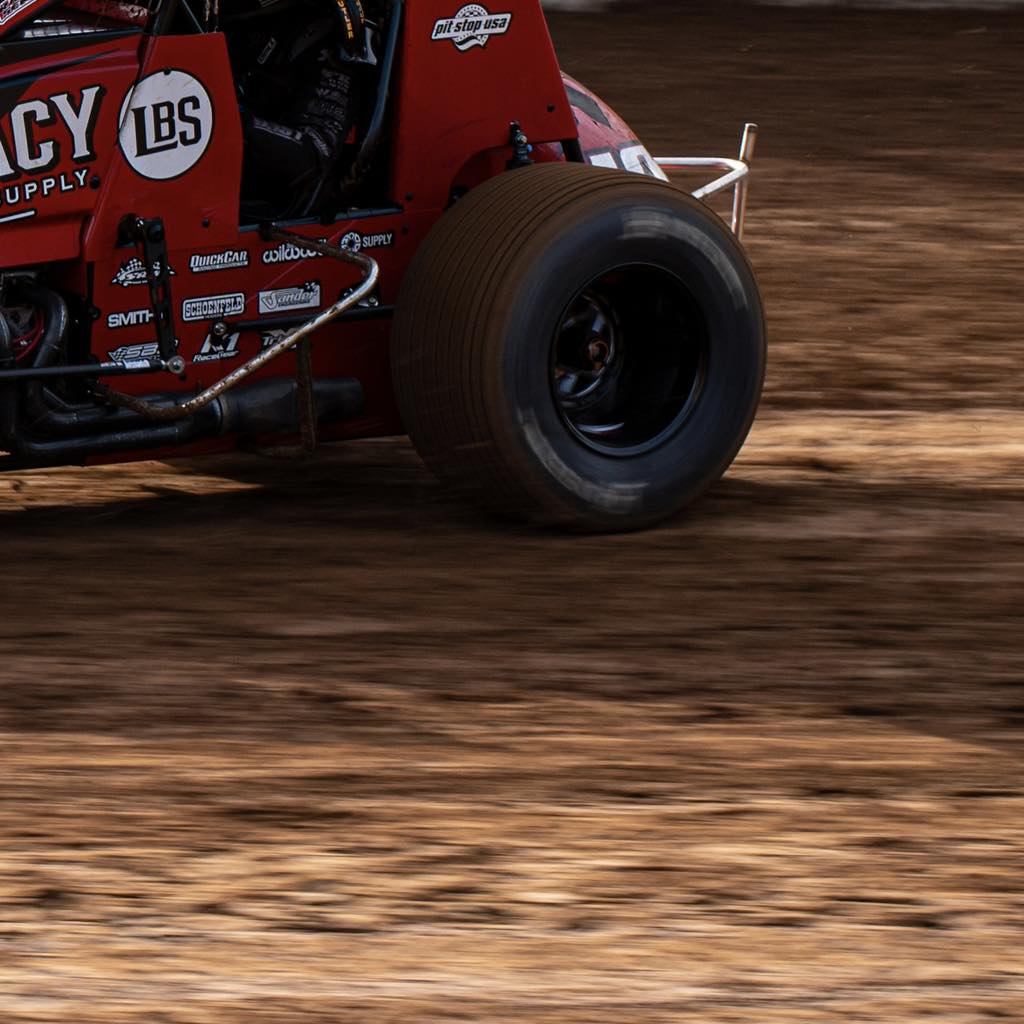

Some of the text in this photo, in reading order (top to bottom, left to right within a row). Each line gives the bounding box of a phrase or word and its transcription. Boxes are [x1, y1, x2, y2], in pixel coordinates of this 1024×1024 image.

[434, 16, 507, 37] pit stop usa
[130, 95, 203, 158] LBS
[363, 233, 392, 247] SUPPLY
[185, 296, 243, 317] SCHOENFELD
